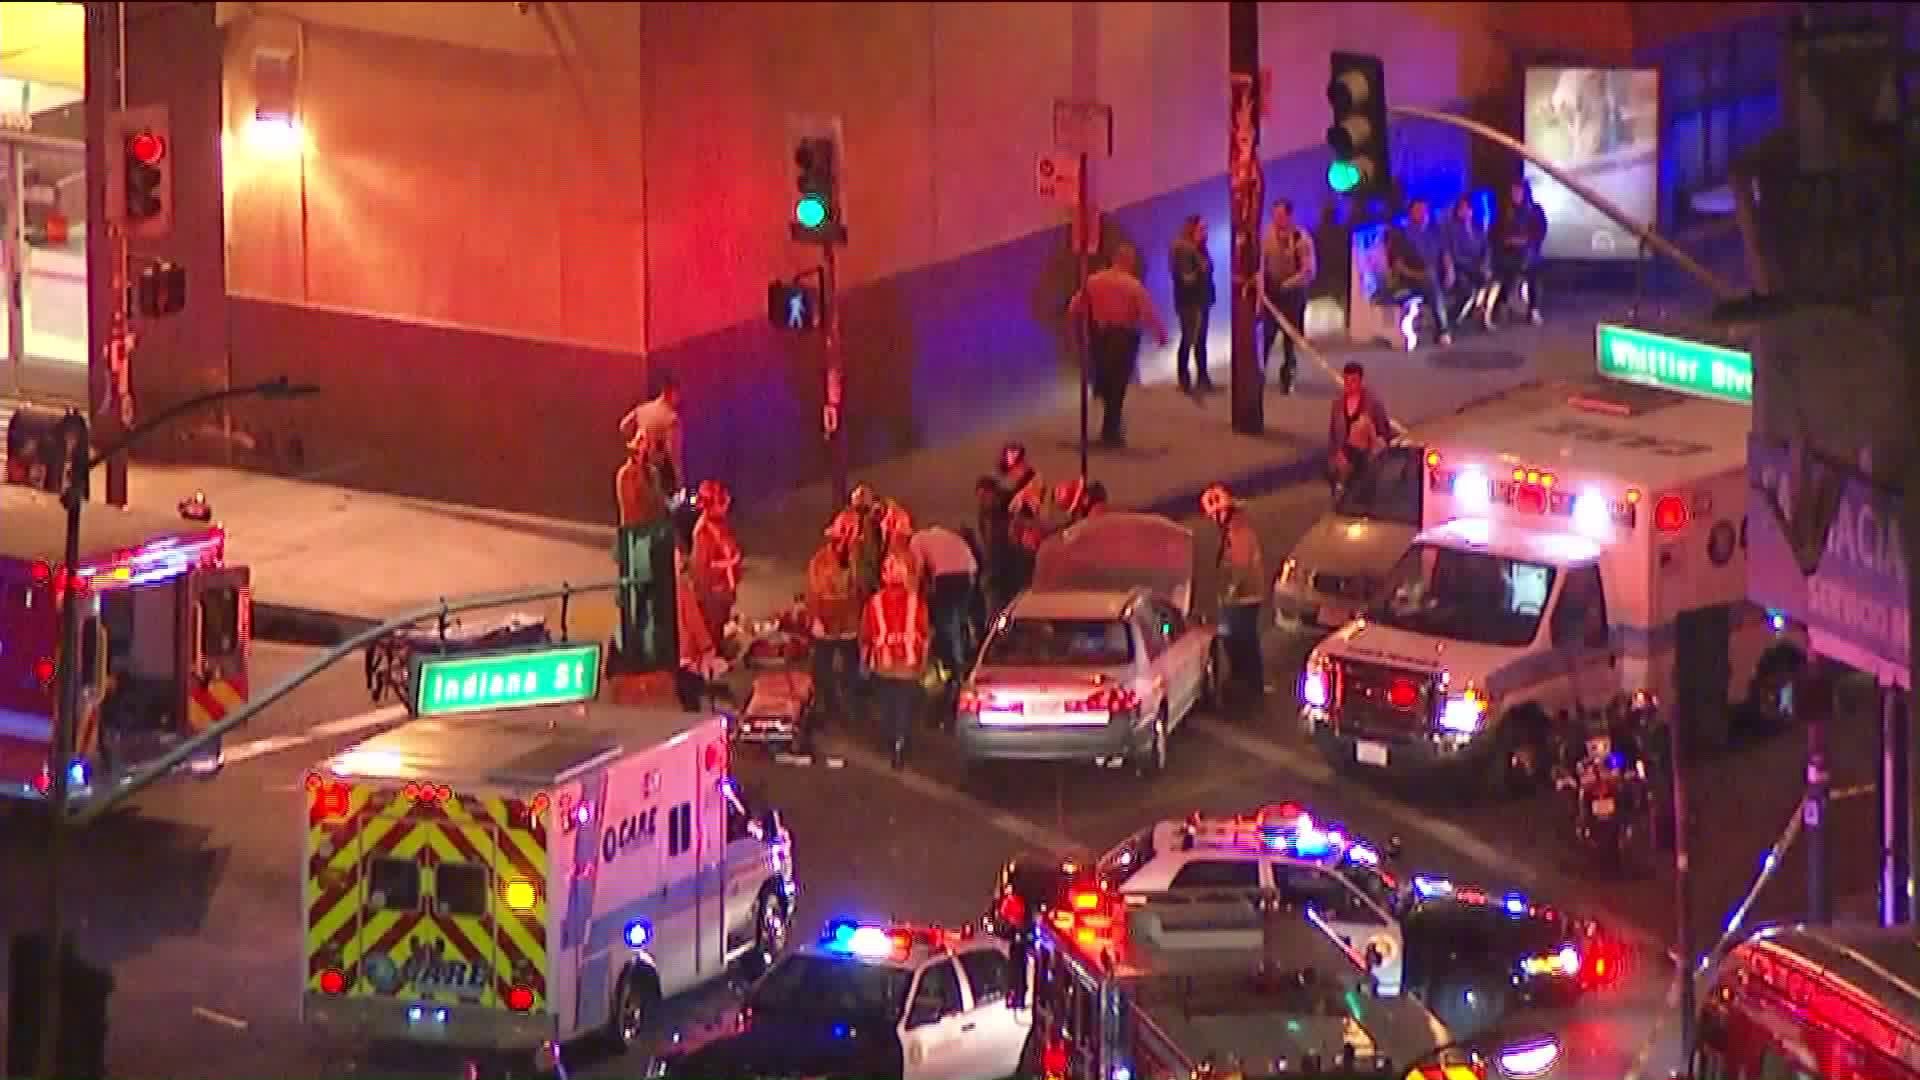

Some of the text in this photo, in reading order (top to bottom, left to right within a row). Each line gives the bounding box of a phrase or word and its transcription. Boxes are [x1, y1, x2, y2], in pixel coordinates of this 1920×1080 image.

[1611, 336, 1697, 382] Whittier
[433, 660, 585, 704] Indiana St
[619, 806, 658, 849] CARE
